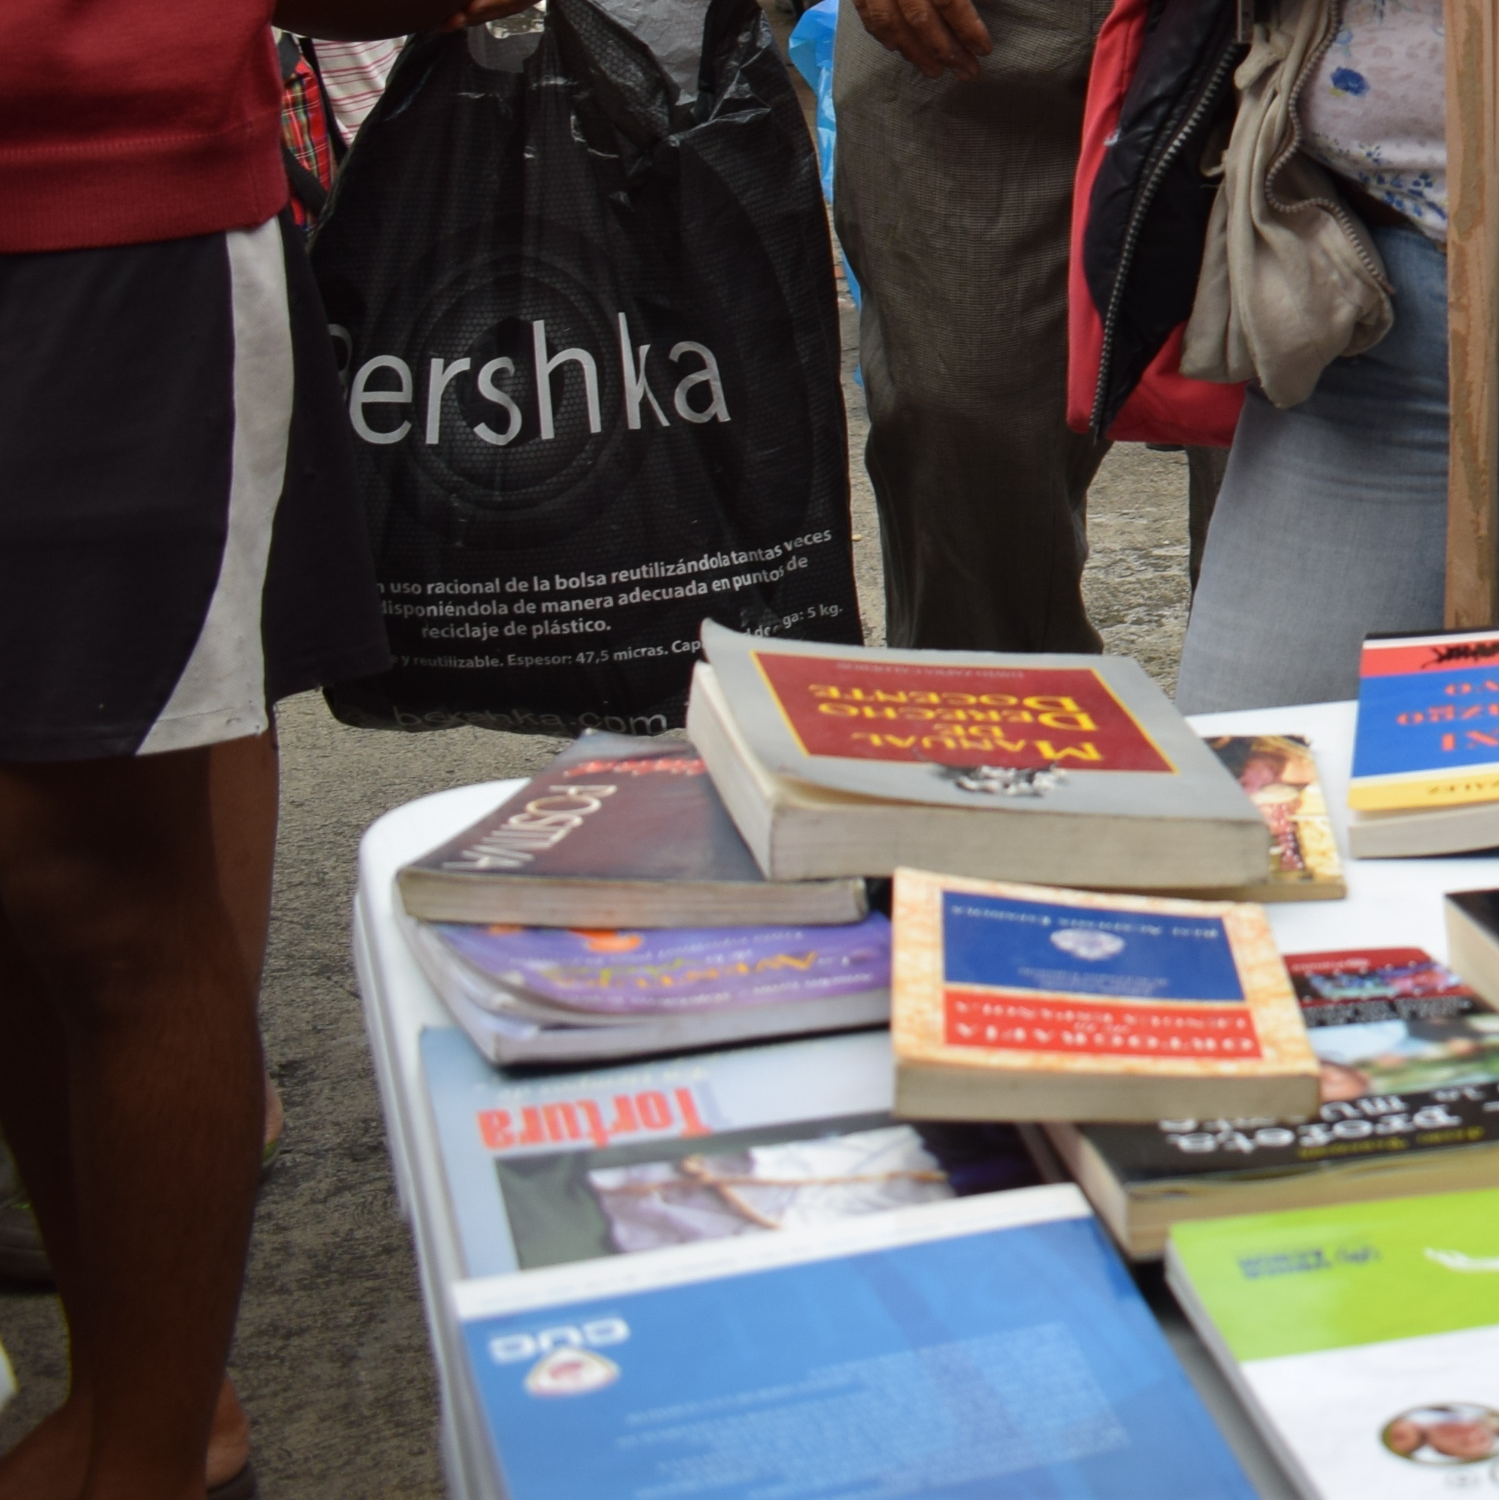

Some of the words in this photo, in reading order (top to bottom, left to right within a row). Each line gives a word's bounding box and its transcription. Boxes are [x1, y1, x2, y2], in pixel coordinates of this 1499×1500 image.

[389, 582, 423, 594] uso
[426, 577, 501, 595] racional
[504, 575, 530, 593] de
[532, 575, 551, 592] la
[554, 571, 608, 591] bolsa
[610, 552, 731, 585] reutilizándola
[730, 544, 783, 566] tantas
[782, 528, 833, 552] veces
[512, 598, 537, 614] de
[541, 595, 614, 614] manera
[617, 580, 709, 606] adecuada
[711, 577, 731, 593] en
[732, 565, 785, 592] puntos
[786, 555, 809, 572] de
[413, 653, 504, 669] reutilizable.
[507, 653, 573, 668] Espesor:
[575, 650, 610, 665] 47,5
[612, 643, 669, 662] micras.
[421, 622, 500, 642] reciclaje
[503, 619, 528, 637] de
[531, 618, 612, 640] plástico.
[476, 1086, 714, 1151] Tortura
